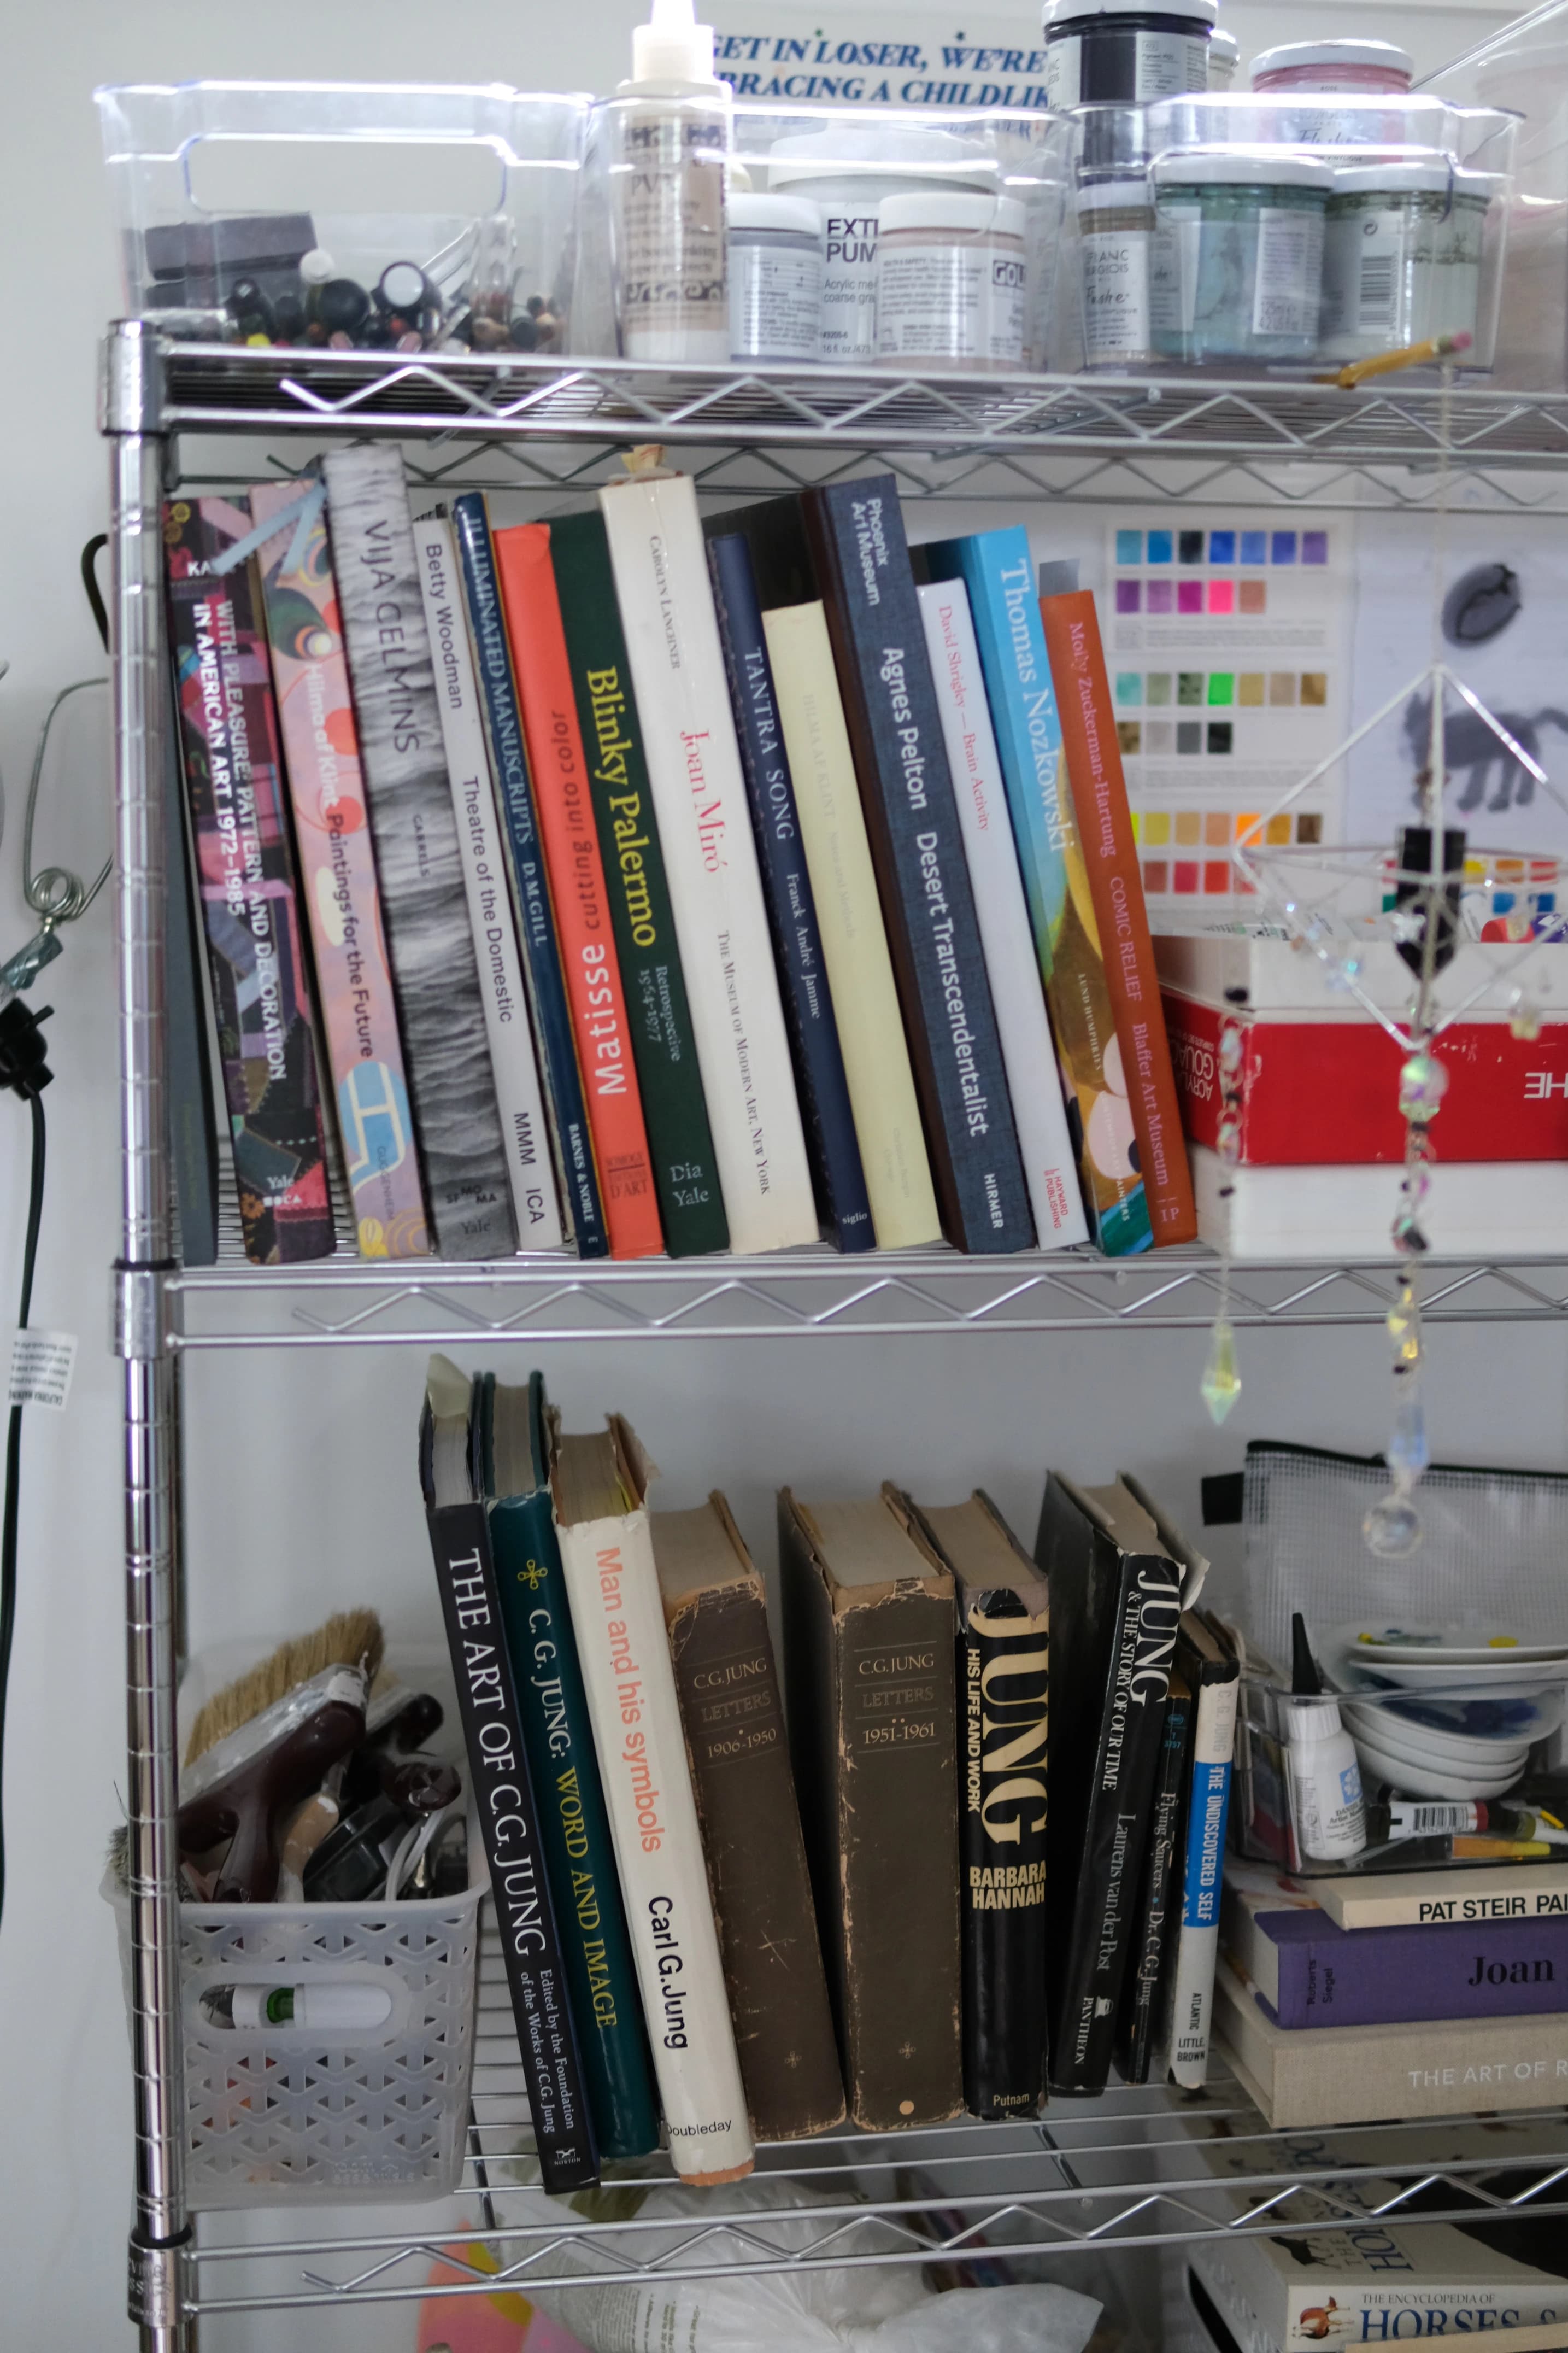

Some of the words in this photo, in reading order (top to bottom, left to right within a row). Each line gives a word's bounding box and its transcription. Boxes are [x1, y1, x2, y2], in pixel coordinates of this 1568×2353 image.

[772, 40, 810, 62] IN
[814, 40, 929, 72] LOSER,
[870, 80, 891, 101] A
[824, 293, 855, 303] coarse
[825, 279, 856, 291] Acrylic
[360, 519, 396, 590] VIJA
[867, 497, 888, 567] Phoenix
[425, 543, 447, 601] Betty
[649, 535, 669, 599] CAROLYN
[855, 532, 881, 606] Museum
[193, 603, 212, 628] IN
[216, 599, 238, 656] WITH
[938, 605, 956, 648] David
[437, 605, 463, 710] Woodman
[1069, 621, 1089, 674] Molly
[196, 633, 226, 747] AMERICAN
[307, 664, 325, 724] Hilma
[375, 604, 420, 754] CELMINS
[468, 517, 505, 678] ILLUMINATED
[491, 686, 530, 845] MANUSCRIPTS
[880, 647, 911, 723] Agnes
[946, 649, 966, 709] Shrigley
[1000, 557, 1038, 685] Thomas
[1024, 688, 1075, 853] Nozkowski
[549, 710, 575, 772] color
[744, 646, 778, 755] TANTRA
[766, 768, 795, 841] SONG
[962, 733, 978, 774] Brain
[213, 752, 232, 798] ART
[318, 756, 340, 807] Klint
[897, 731, 930, 811] Pelton
[1077, 676, 1117, 859] Zuckerman-Hartung
[462, 775, 488, 857] Theatre
[562, 781, 584, 833] into
[586, 665, 630, 786] Blinky
[609, 791, 656, 947] Palermo
[679, 729, 710, 795] Joan
[695, 799, 729, 874] Miró
[970, 775, 989, 832] Activity
[237, 788, 265, 891] PATTERN
[327, 813, 352, 917] Paintings
[786, 873, 807, 920] Franck
[916, 832, 948, 917] Desert
[250, 890, 269, 935] AND
[479, 887, 495, 922] the
[1109, 876, 1131, 935] COMIC
[341, 916, 361, 947] for
[795, 926, 813, 967] André
[346, 952, 364, 986] the
[486, 927, 512, 1023] Domestic
[723, 959, 740, 1016] MUSEUM
[1119, 940, 1143, 1002] RELIEF
[254, 942, 287, 1080] DECORATION
[582, 943, 627, 1096] Matisse
[655, 964, 682, 1062] Retrospective
[801, 973, 820, 1019] Jamme
[351, 989, 374, 1058] Future
[931, 917, 989, 1138] Transcendentalist
[736, 1037, 754, 1094] MODERN
[1141, 1083, 1157, 1111] Art
[513, 1111, 537, 1166] MMM
[750, 1127, 765, 1157] NEW
[1145, 1113, 1170, 1186] Museum
[267, 1174, 294, 1190] Yale
[568, 1123, 585, 1170] BARNES
[579, 1184, 594, 1223] NOBLE
[669, 1162, 703, 1183] Dia
[673, 1187, 709, 1207] Yale
[756, 1159, 771, 1195] YORK
[1053, 1175, 1068, 1217] HAYWARD
[525, 1188, 545, 1225] ICA
[842, 1211, 868, 1226] siglio
[983, 1172, 1005, 1230] HIRMER
[1044, 1177, 1062, 1230] PUBLISHING
[448, 1547, 491, 1630] THE
[596, 1546, 625, 1613] Man
[1123, 1605, 1141, 1639] THE
[1129, 1569, 1181, 1708] JUNG
[607, 1620, 640, 1676] and
[967, 1648, 980, 1678] HIS
[1116, 1642, 1135, 1690] STORY
[463, 1640, 506, 1712] ART
[862, 1685, 935, 1708] LETTERS
[967, 1681, 980, 1716] LIFE
[530, 1675, 572, 1759] JUNG:
[617, 1681, 646, 1725] his
[701, 1690, 773, 1722] LETTERS
[968, 1602, 1049, 1846] JUNG
[1113, 1691, 1129, 1713] OF
[478, 1722, 517, 1773] OF
[707, 1728, 777, 1759] 1906-1950
[862, 1722, 936, 1745] 1951-1961
[968, 1718, 980, 1757] AND
[1108, 1714, 1126, 1748] OUR
[621, 1732, 666, 1854] symbols
[967, 1760, 980, 1813] WORK
[1102, 1750, 1121, 1791] TIME
[1208, 1766, 1225, 1791] THE
[555, 1766, 589, 1858] WORD
[1154, 1792, 1177, 1836] Flying
[1109, 1813, 1136, 1878] Laurens
[1153, 1839, 1171, 1890] Saucers
[1200, 1795, 1224, 1886] UNDISCOVERED
[570, 1868, 601, 1931] AND
[969, 1860, 1047, 1889] BARBARA
[972, 1882, 1046, 1910] HANNAH
[1105, 1880, 1121, 1910] van
[494, 1852, 546, 1957] JUNG
[648, 1895, 679, 1950] Carl
[1101, 1911, 1122, 1938] der
[1197, 1892, 1214, 1921] SELF
[1419, 1901, 1457, 1921] PAT
[1463, 1897, 1526, 1918] STEIR
[521, 1971, 534, 1986] of
[1096, 1940, 1118, 1971] Post
[1468, 1956, 1555, 1987] Joan
[524, 1989, 536, 2010] the
[539, 1969, 558, 2011] Edited
[583, 1938, 618, 2029] IMAGE
[528, 2012, 544, 2054] Works
[545, 2013, 559, 2030] by
[1074, 1996, 1094, 2065] PANTHEON
[1189, 1992, 1202, 2030] ATLANTIC
[535, 2057, 549, 2070] of
[551, 2033, 564, 2055] the
[1177, 2051, 1205, 2062] BROWN
[555, 2057, 574, 2130] Foundation
[993, 2092, 1031, 2108] Putnam
[1408, 2068, 1455, 2088] THE
[1463, 2064, 1507, 2083] ART
[1514, 2061, 1547, 2079] OF
[1363, 2293, 1385, 2304] THE
[1388, 2293, 1478, 2304] ENCYCLOPEDIA
[1479, 2293, 1496, 2304] OF
